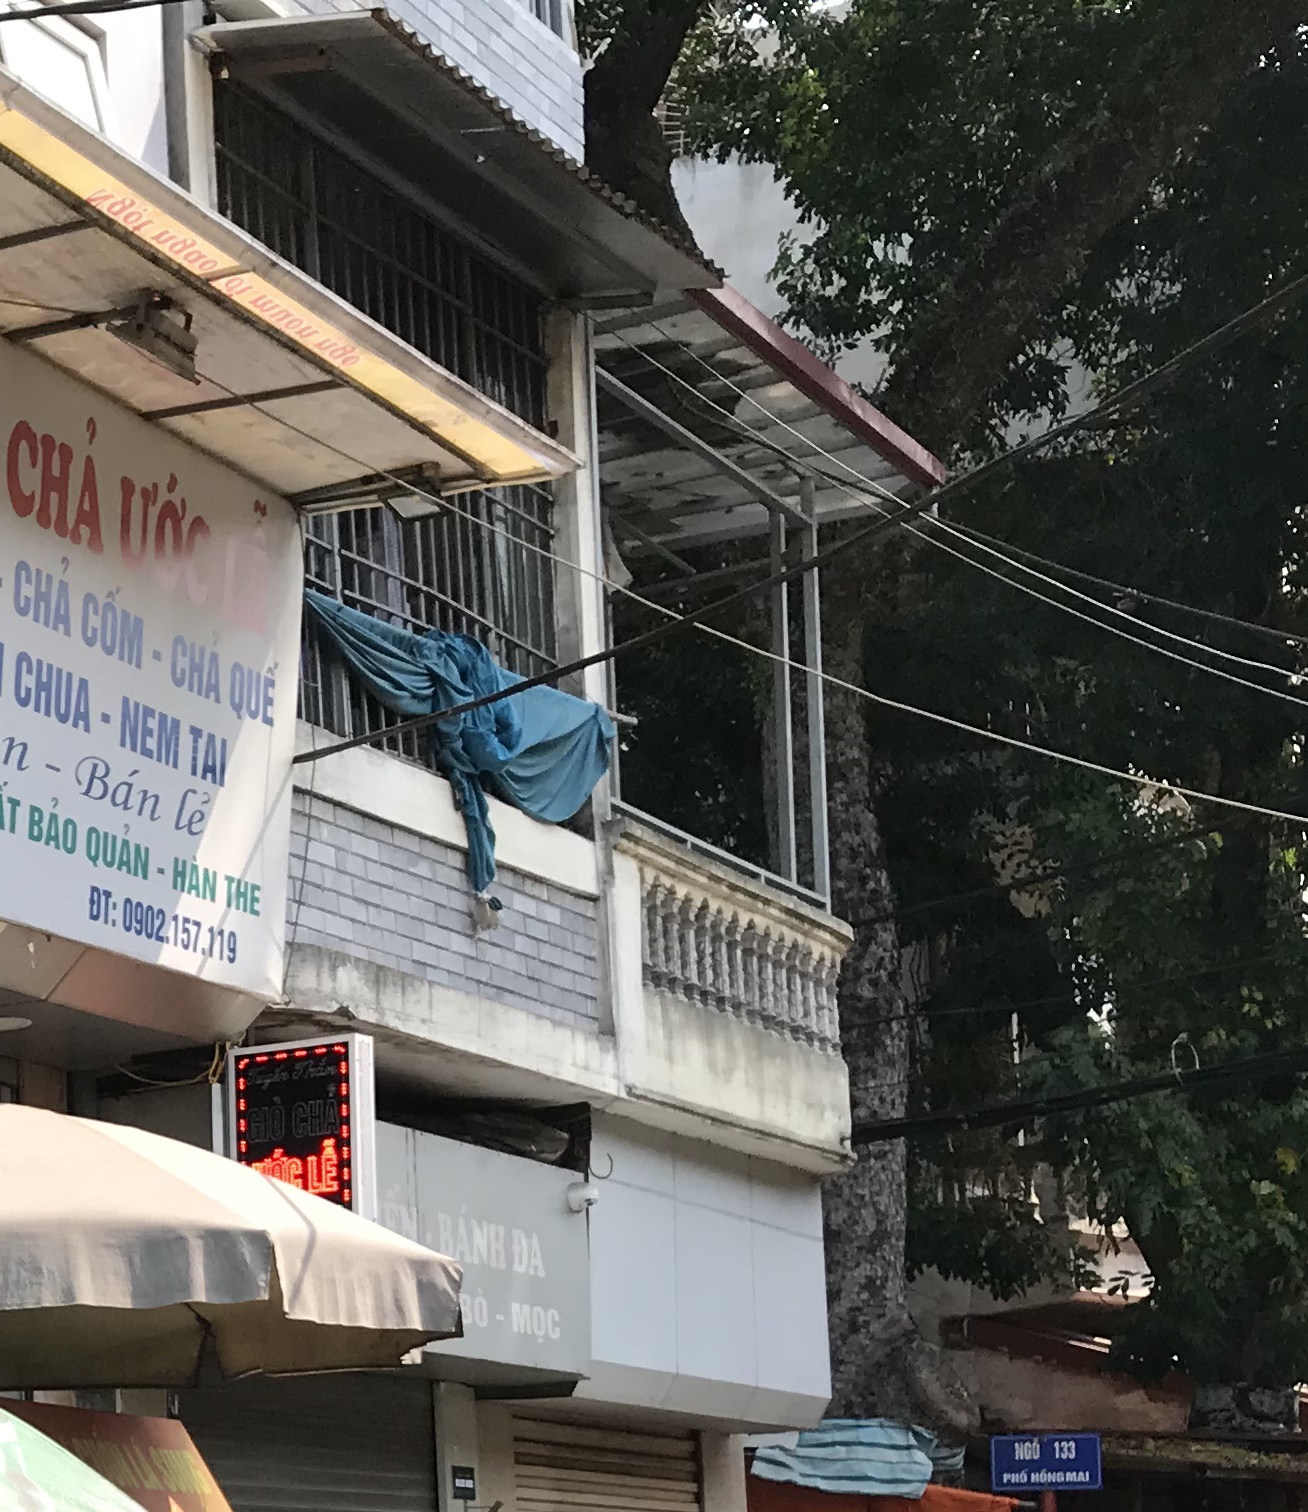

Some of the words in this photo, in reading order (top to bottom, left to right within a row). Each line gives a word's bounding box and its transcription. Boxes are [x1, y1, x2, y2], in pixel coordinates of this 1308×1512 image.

[6, 417, 105, 555] CHẢ
[12, 555, 72, 639] CHẢ
[81, 586, 145, 670] CỐM
[170, 632, 221, 706] CHẢ
[228, 661, 277, 729] QUẾ
[14, 651, 92, 734] CHUA
[119, 695, 181, 771] NEM
[188, 725, 228, 788] TAI
[75, 755, 162, 822] Bán
[173, 788, 211, 837] lẻ
[28, 795, 78, 855] BẢO
[85, 822, 151, 881] QUẢN
[172, 853, 218, 905] HÀN
[224, 873, 262, 917] THE
[88, 885, 118, 928] ĐT:
[122, 897, 239, 965] 0902.157.119
[511, 1227, 546, 1278] ĐA
[511, 1302, 561, 1344] MỌC
[1053, 1440, 1077, 1460] 133
[1065, 1469, 1090, 1483] MAI
